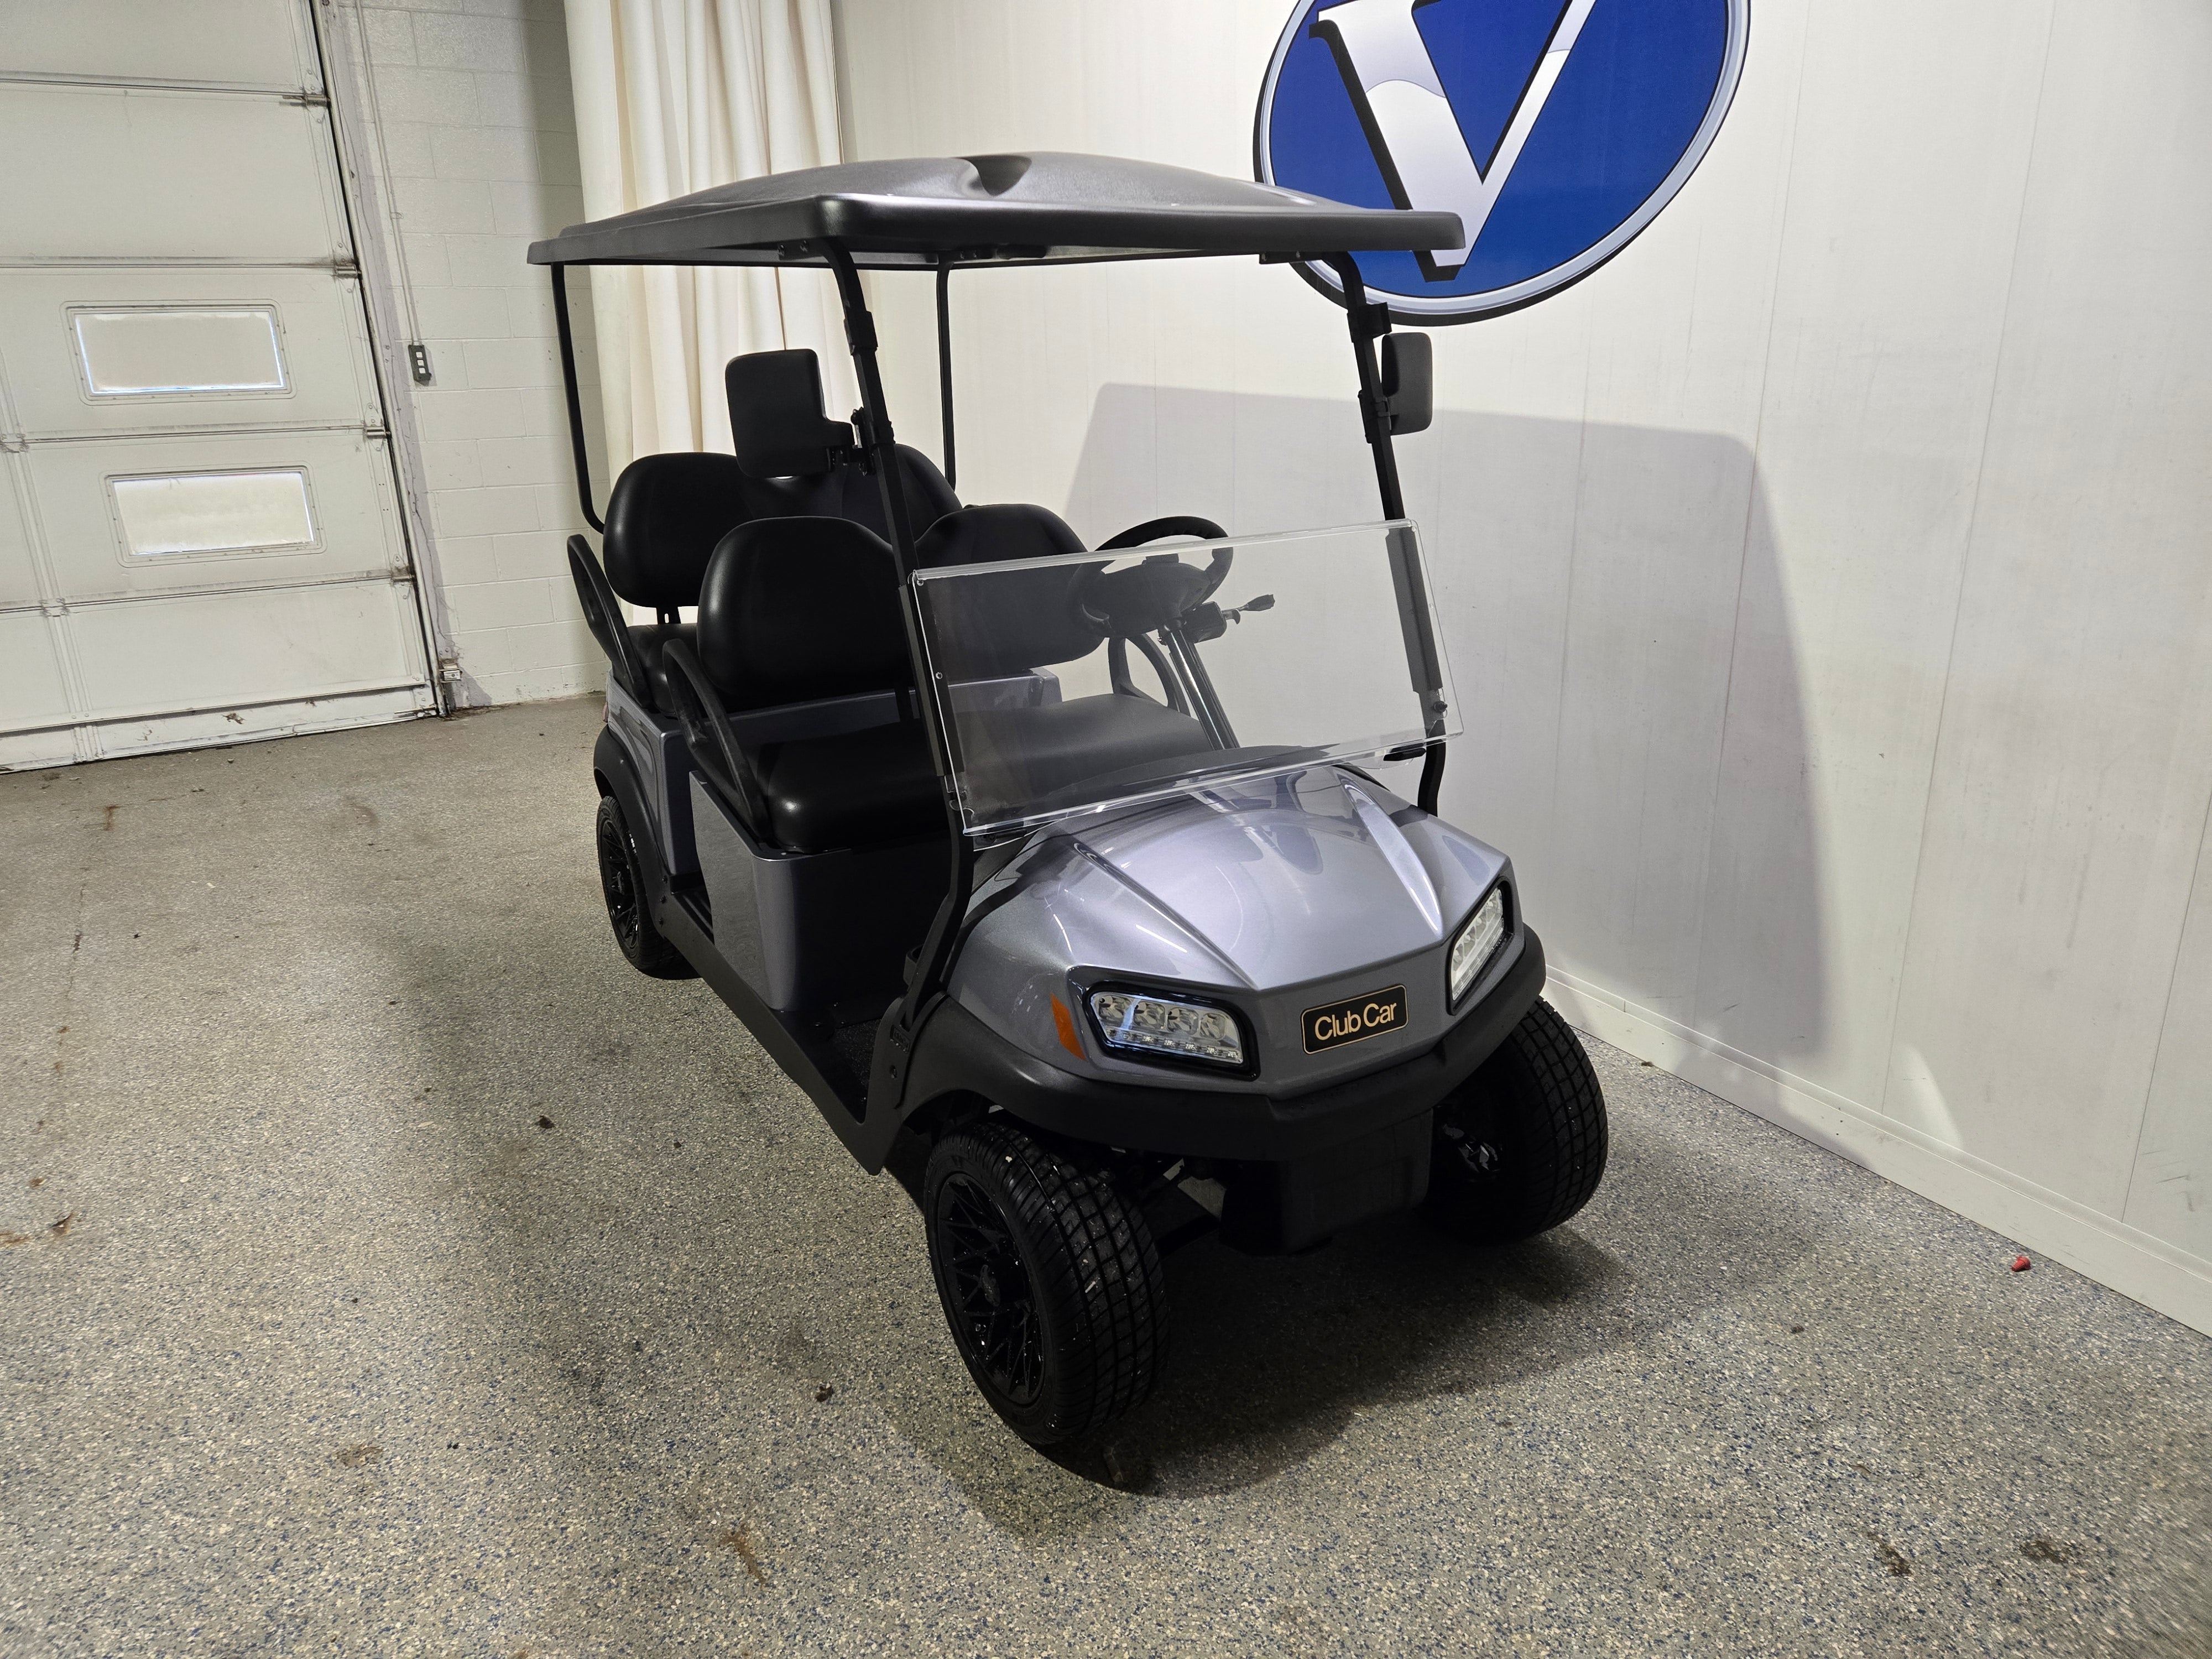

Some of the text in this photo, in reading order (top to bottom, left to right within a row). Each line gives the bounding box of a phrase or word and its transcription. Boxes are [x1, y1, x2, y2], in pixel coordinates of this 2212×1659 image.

[1316, 0, 1598, 268] V
[1314, 1002, 1397, 1041] Club Car
